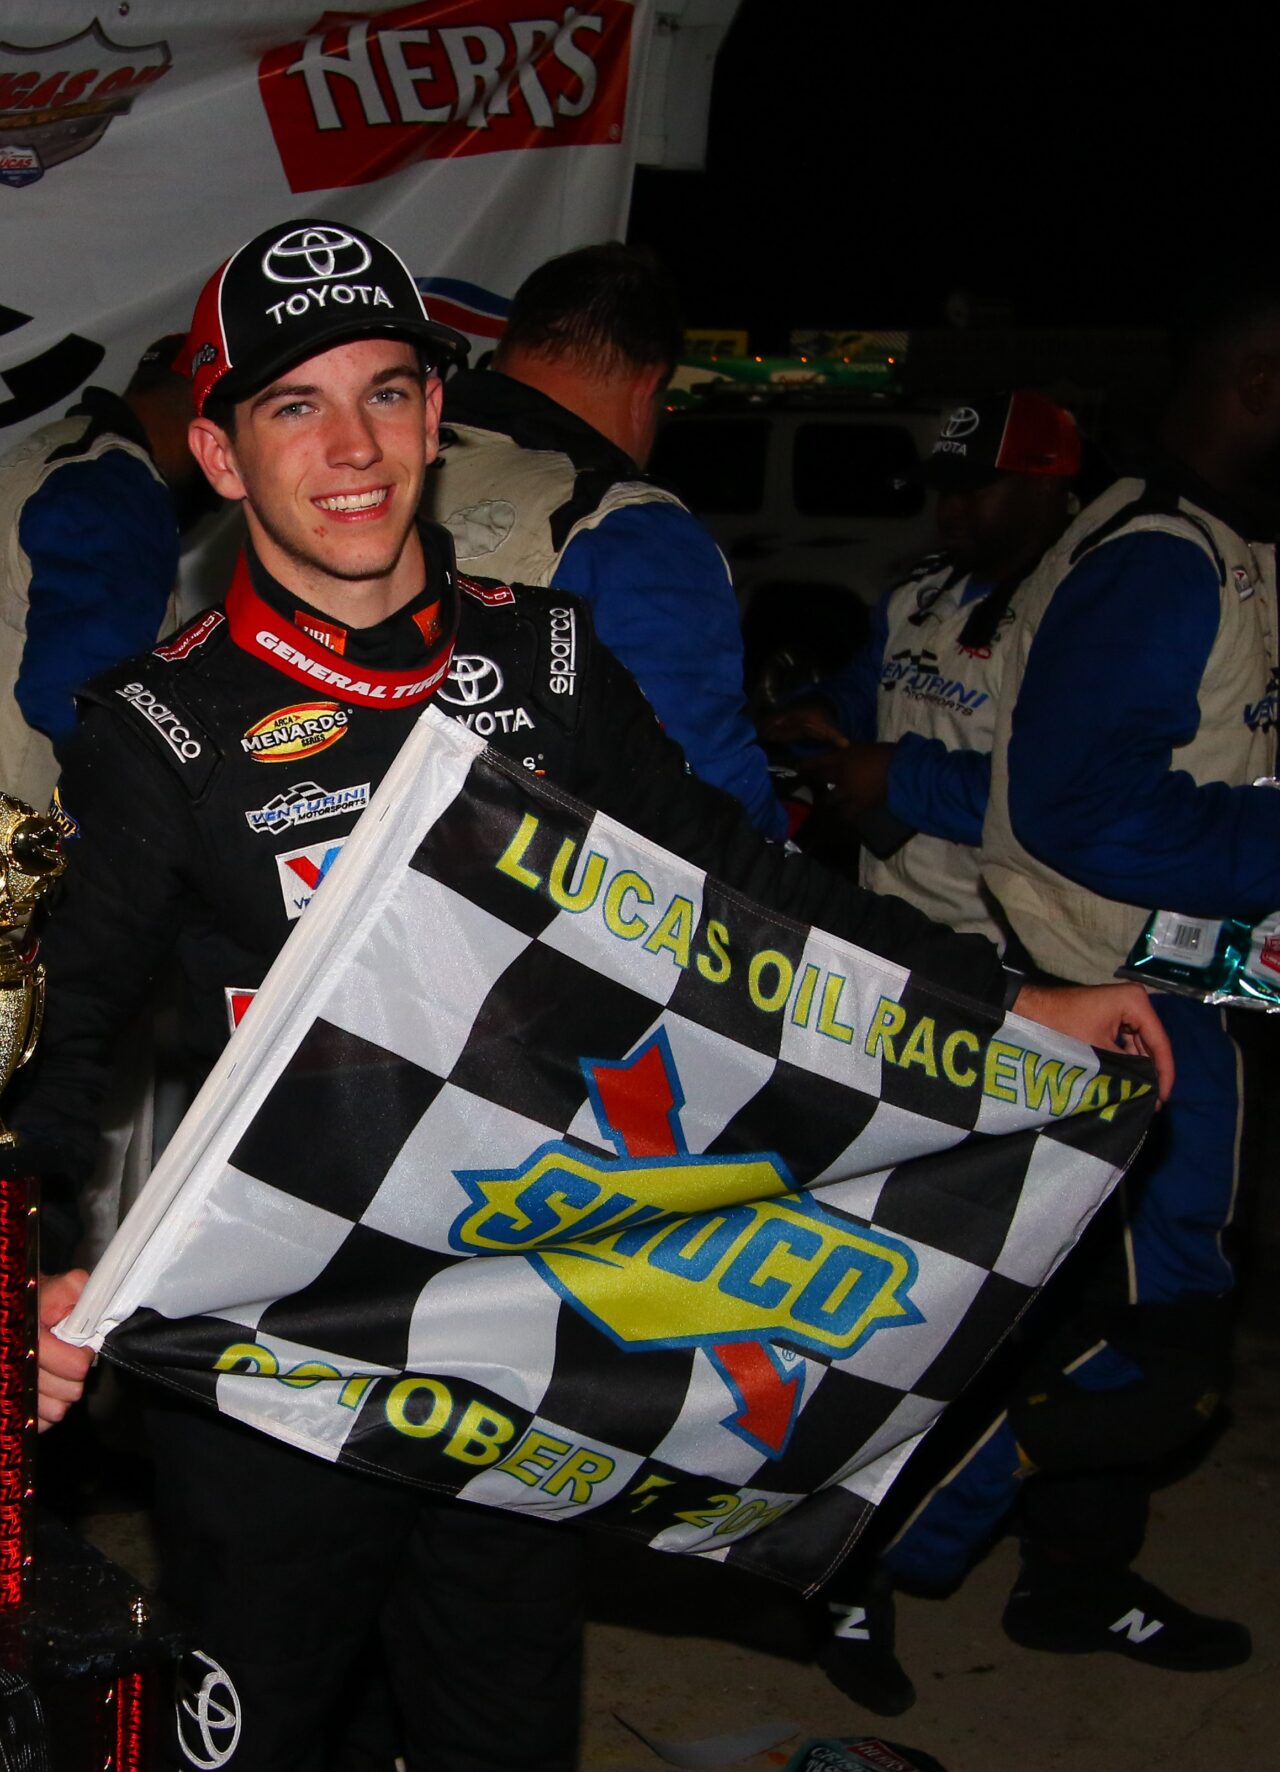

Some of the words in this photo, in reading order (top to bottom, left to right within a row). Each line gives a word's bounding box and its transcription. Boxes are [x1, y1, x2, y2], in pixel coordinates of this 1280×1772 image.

[285, 6, 603, 130] HERR'S
[265, 283, 395, 325] TOYOTA
[255, 630, 387, 699] GENERAL
[391, 660, 449, 699] TIRE
[549, 608, 577, 695] sparco
[115, 682, 202, 762] sparco
[240, 708, 349, 753] MENARDS
[274, 717, 294, 728] ARCA
[301, 733, 326, 748] SERIES
[250, 787, 367, 825] VENTURINI
[298, 798, 367, 821] MOTORSPORTS
[495, 812, 732, 984] LUCAS
[748, 949, 855, 1045] OIL
[863, 994, 1153, 1123] RACEWAY
